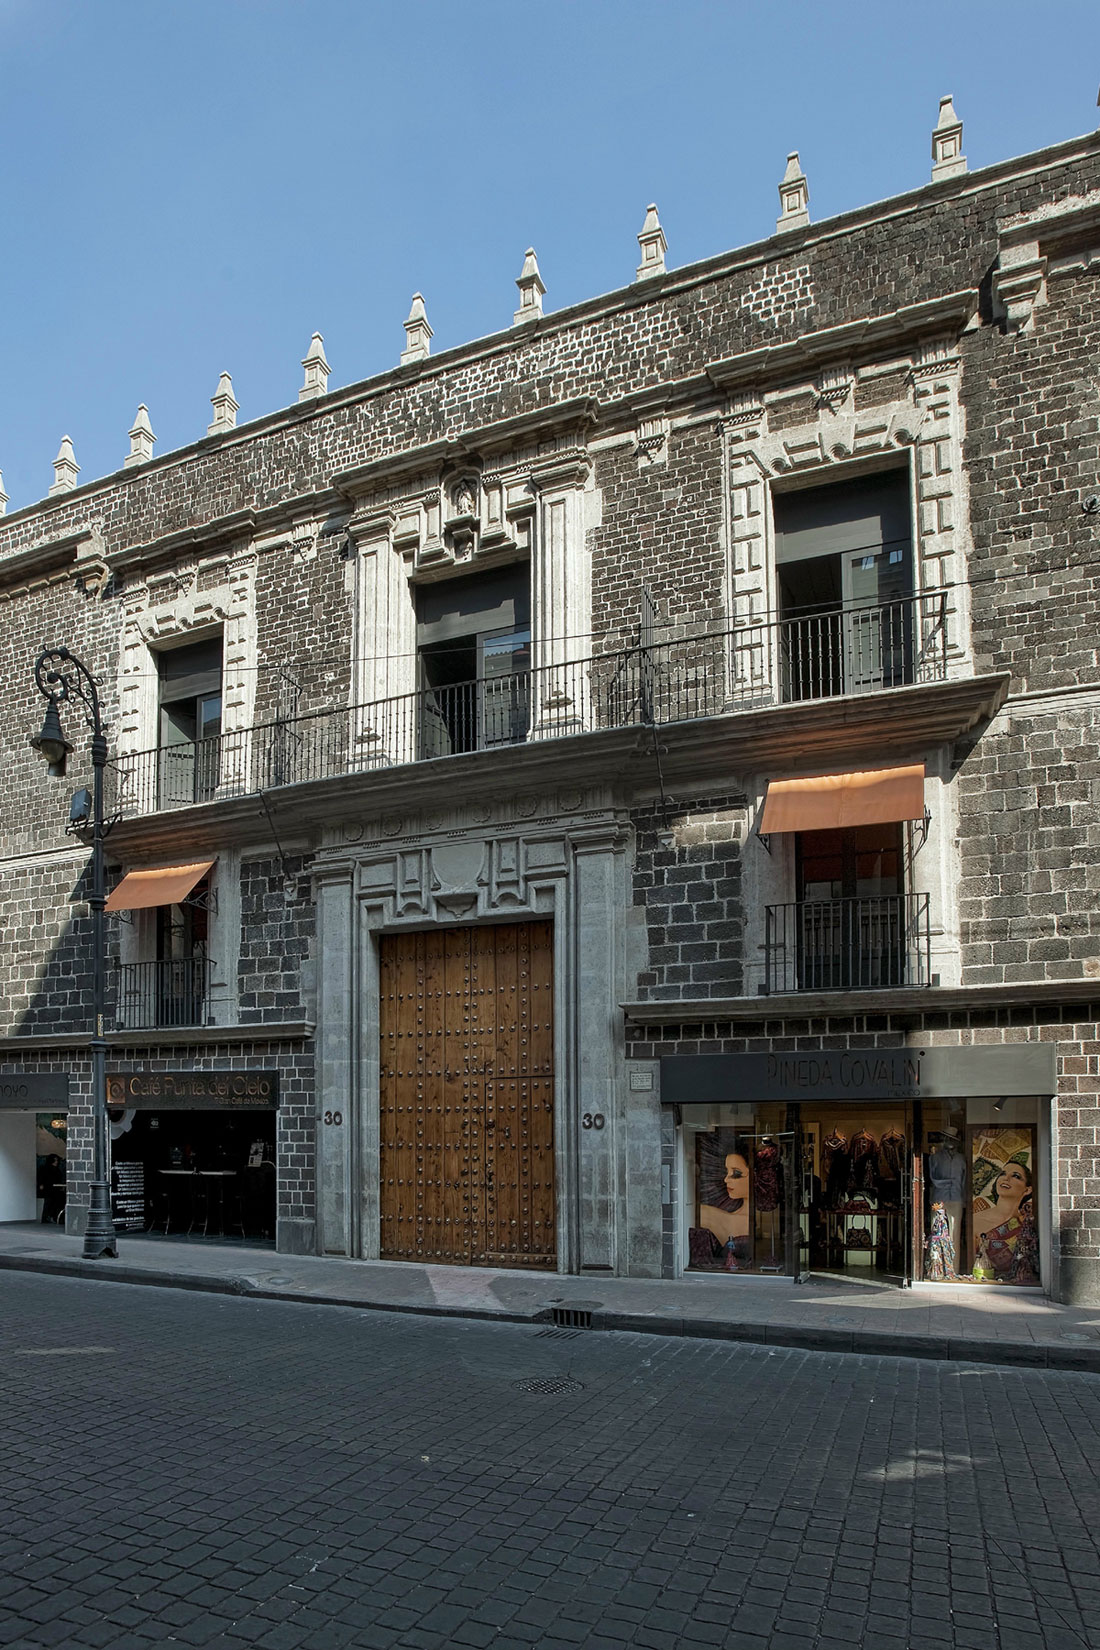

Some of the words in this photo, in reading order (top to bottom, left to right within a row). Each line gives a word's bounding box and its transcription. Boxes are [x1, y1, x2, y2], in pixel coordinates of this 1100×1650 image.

[767, 1054, 834, 1087] PINEDA
[839, 1053, 921, 1087] COVALIN
[129, 1075, 161, 1096] Café
[163, 1076, 206, 1096] Punta
[207, 1075, 230, 1096] del
[232, 1075, 270, 1096] Cielo
[324, 1110, 343, 1126] 30
[582, 1112, 605, 1130] 30
